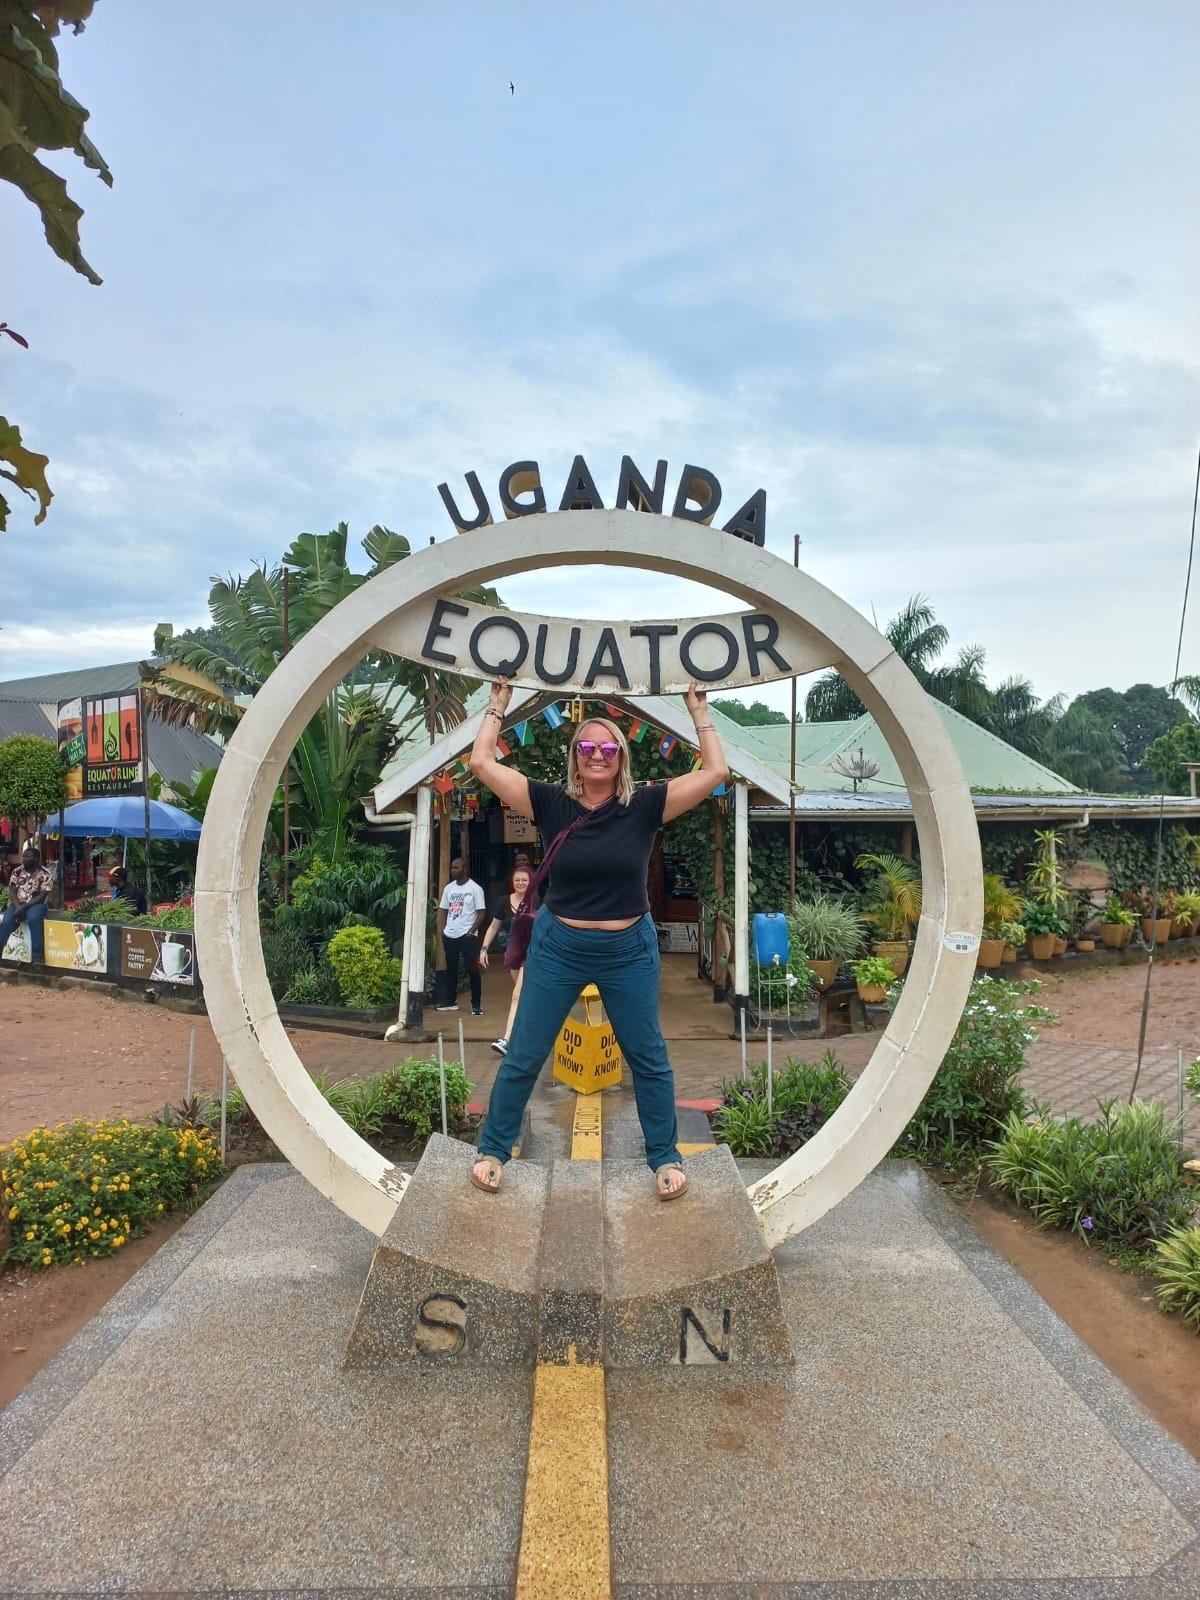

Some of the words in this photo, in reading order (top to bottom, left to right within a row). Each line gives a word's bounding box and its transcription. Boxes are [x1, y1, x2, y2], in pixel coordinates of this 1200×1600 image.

[437, 454, 767, 547] UGANDA
[421, 598, 792, 695] EQUATOR
[128, 953, 145, 962] COFFEE
[563, 1028, 582, 1047] DID
[601, 1033, 617, 1049] DID
[566, 1044, 574, 1055] U
[605, 1048, 612, 1058] U
[557, 1054, 584, 1076] KNOW?
[594, 1058, 620, 1077] KNOW?
[414, 1291, 467, 1358] S
[679, 1306, 732, 1364] N
